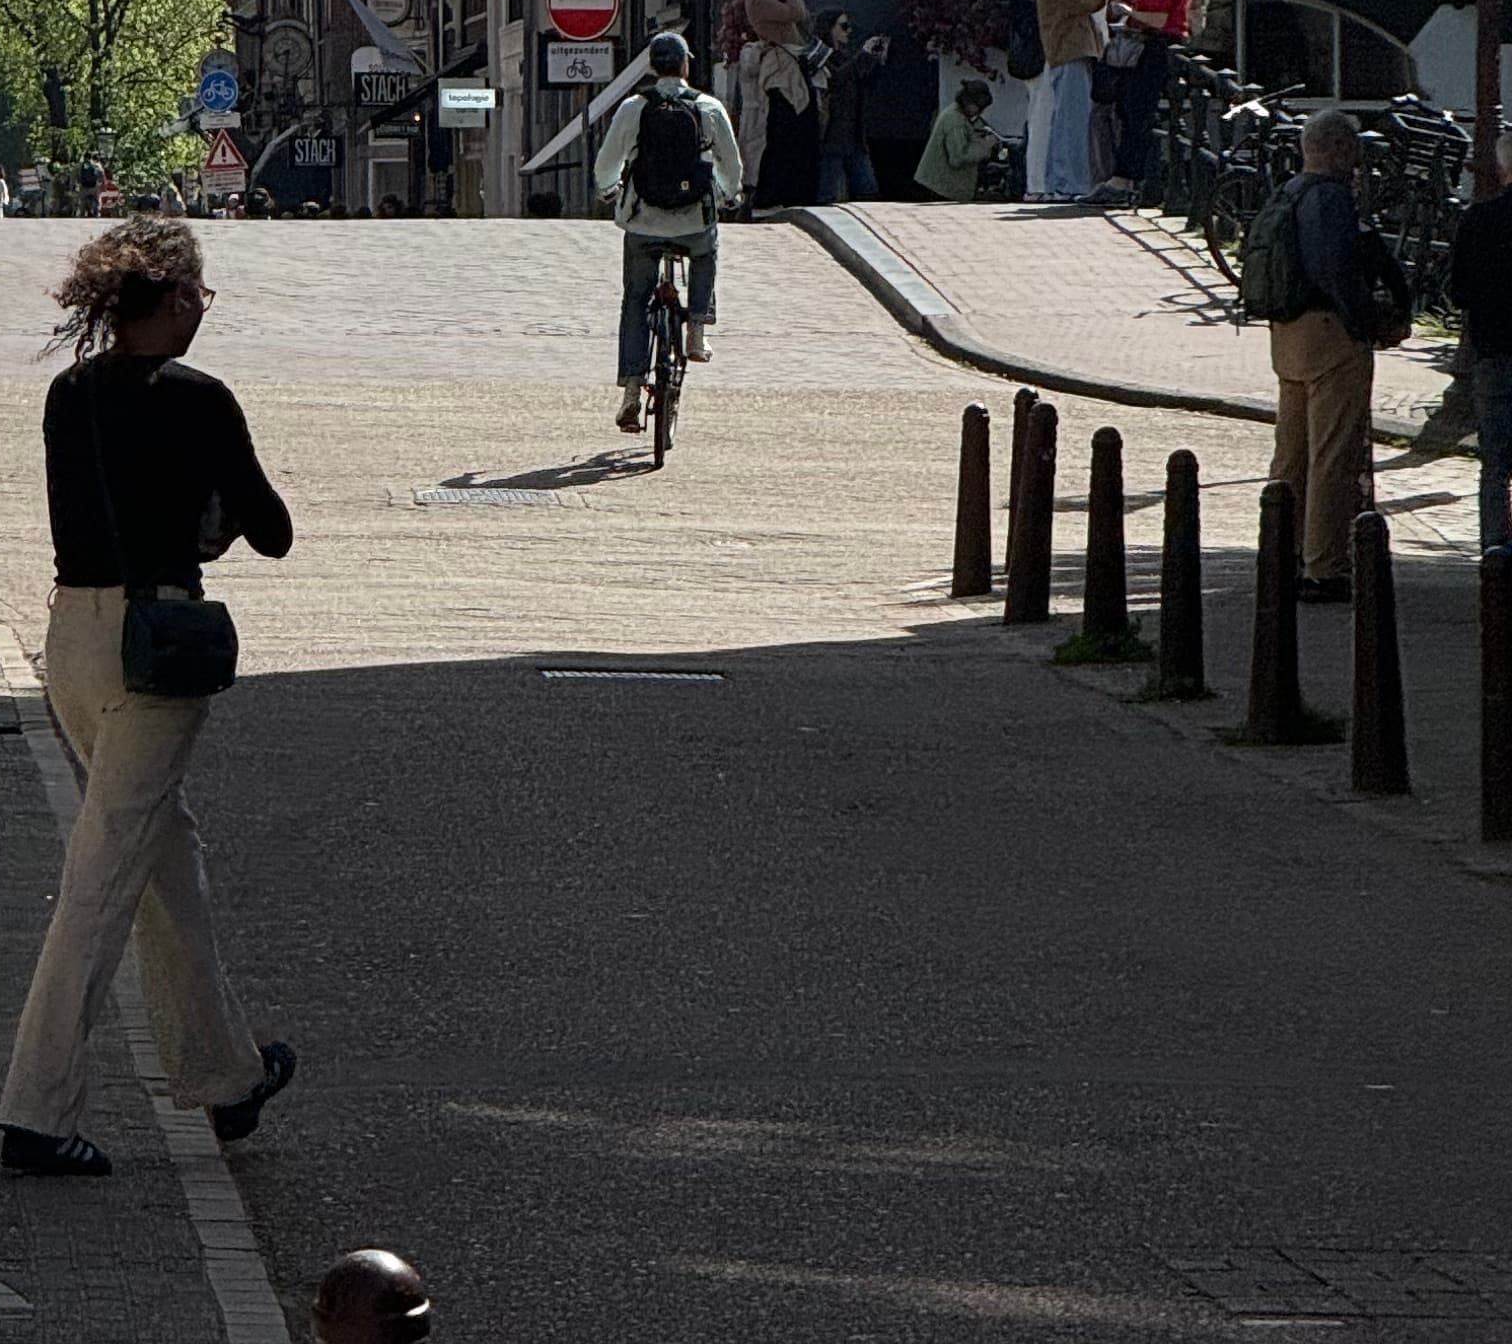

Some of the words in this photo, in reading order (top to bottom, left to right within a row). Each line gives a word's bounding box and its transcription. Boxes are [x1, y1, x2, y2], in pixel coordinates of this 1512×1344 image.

[551, 45, 610, 57] uitgezonderd
[361, 74, 407, 102] STACH
[294, 138, 336, 163] STACH
